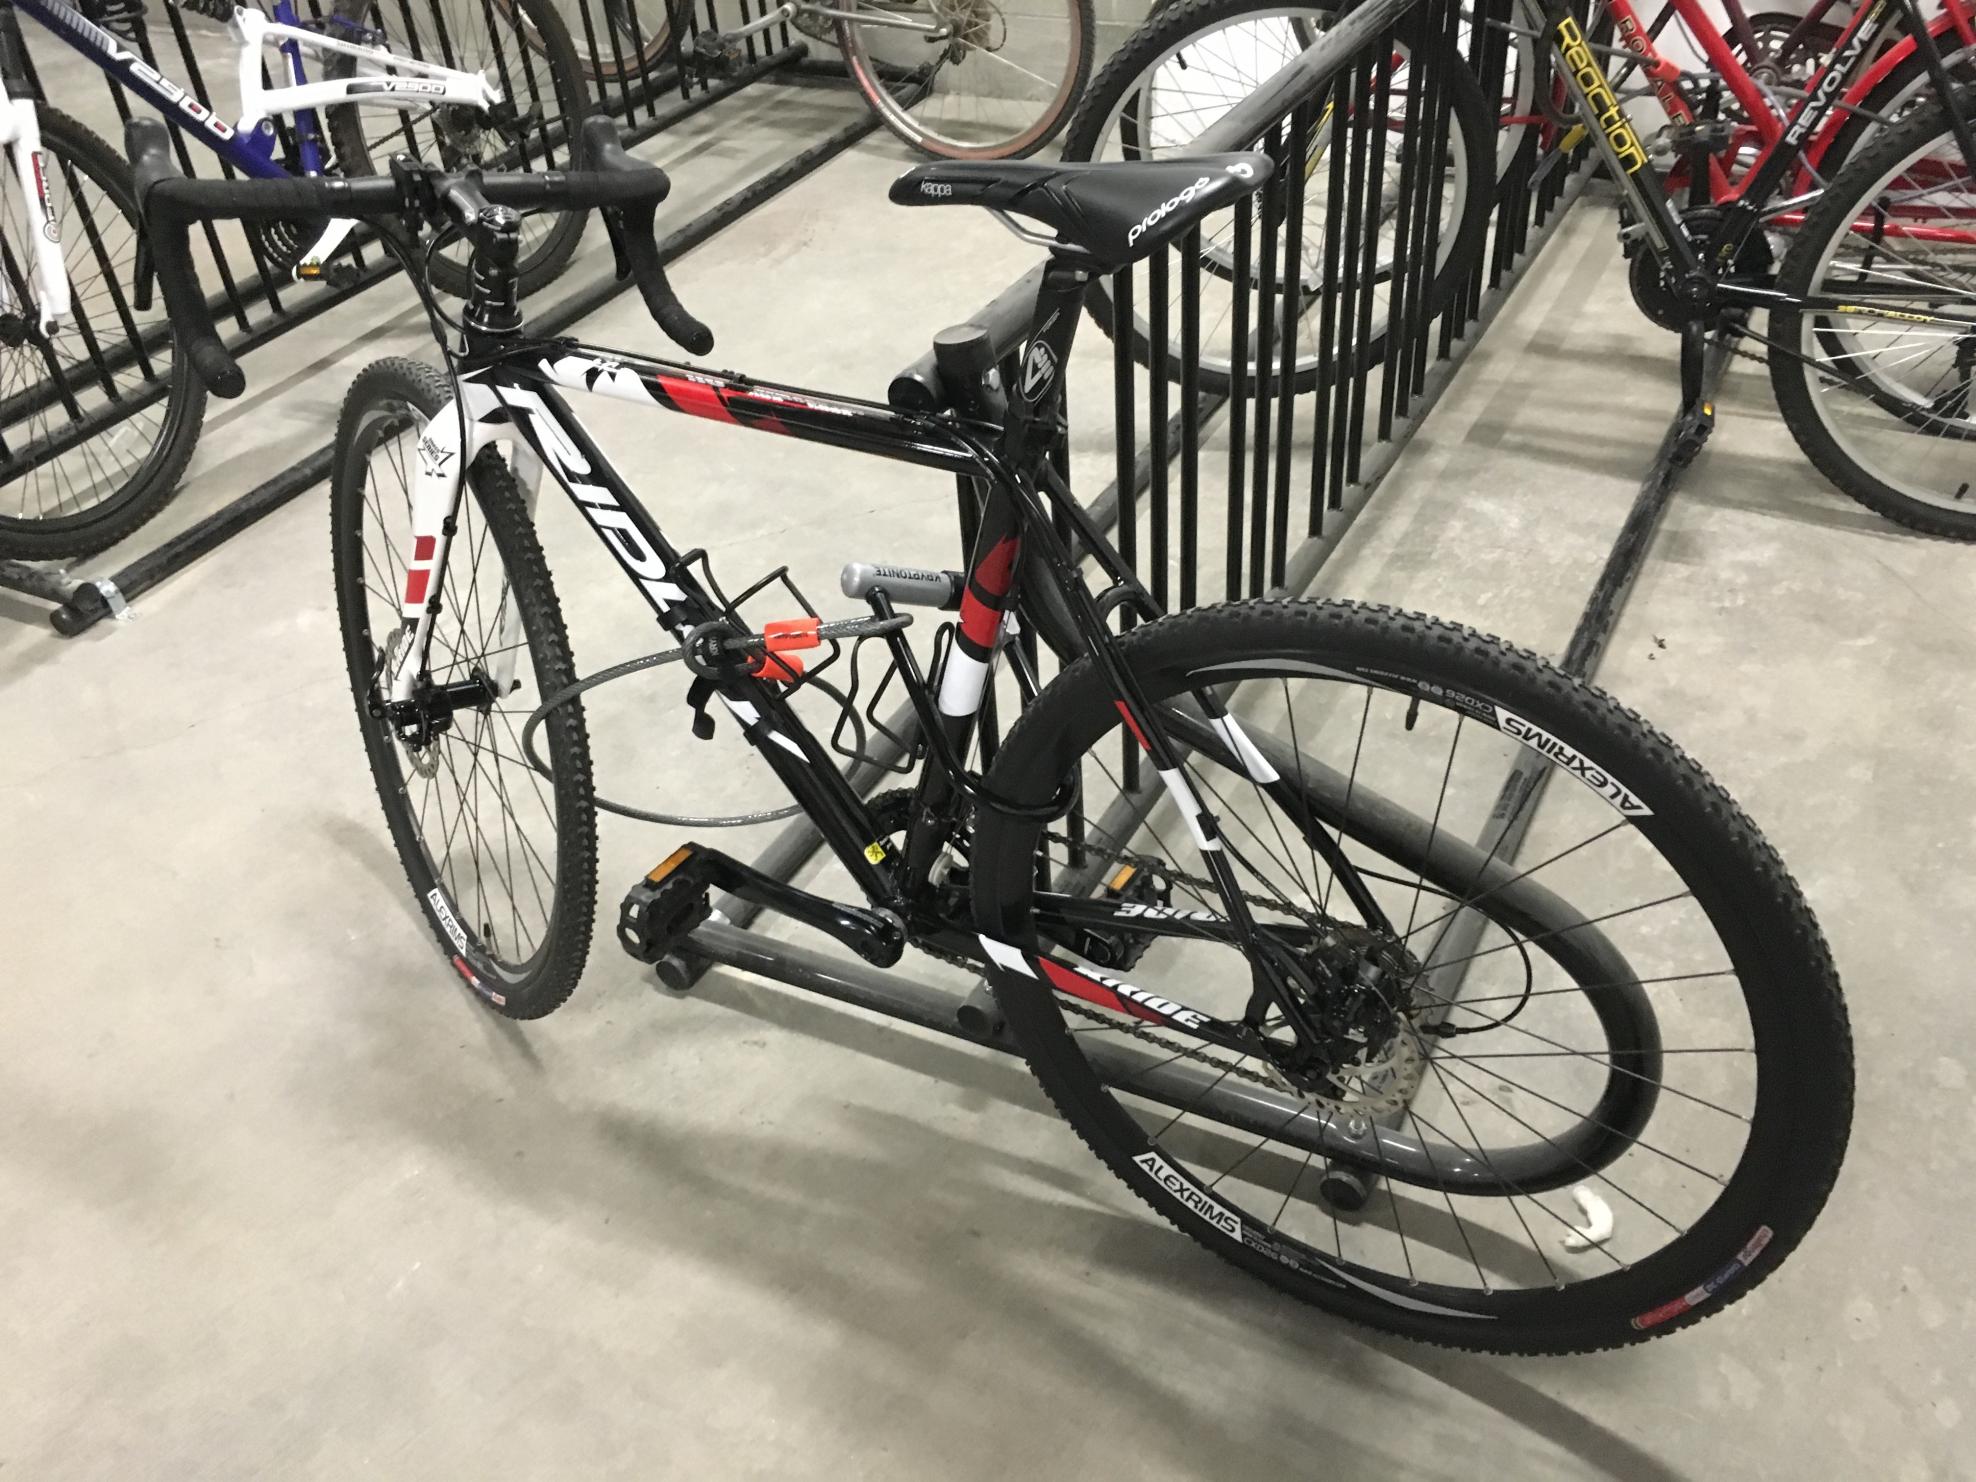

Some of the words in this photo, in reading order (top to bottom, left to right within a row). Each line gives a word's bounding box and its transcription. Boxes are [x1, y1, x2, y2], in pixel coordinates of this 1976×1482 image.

[1556, 16, 1646, 174] Reaction
[1618, 15, 1694, 125] ROALE
[1784, 20, 1879, 146] REVOLVE
[920, 180, 952, 197] kappa
[1127, 176, 1211, 248] prologo
[875, 567, 942, 583] KRYPTONITE
[1446, 689, 1493, 713] CXD26
[1503, 716, 1644, 811] ALEXRIMS
[430, 892, 467, 950] ALEXRIMS
[1140, 1156, 1239, 1234] ALEXRIMS
